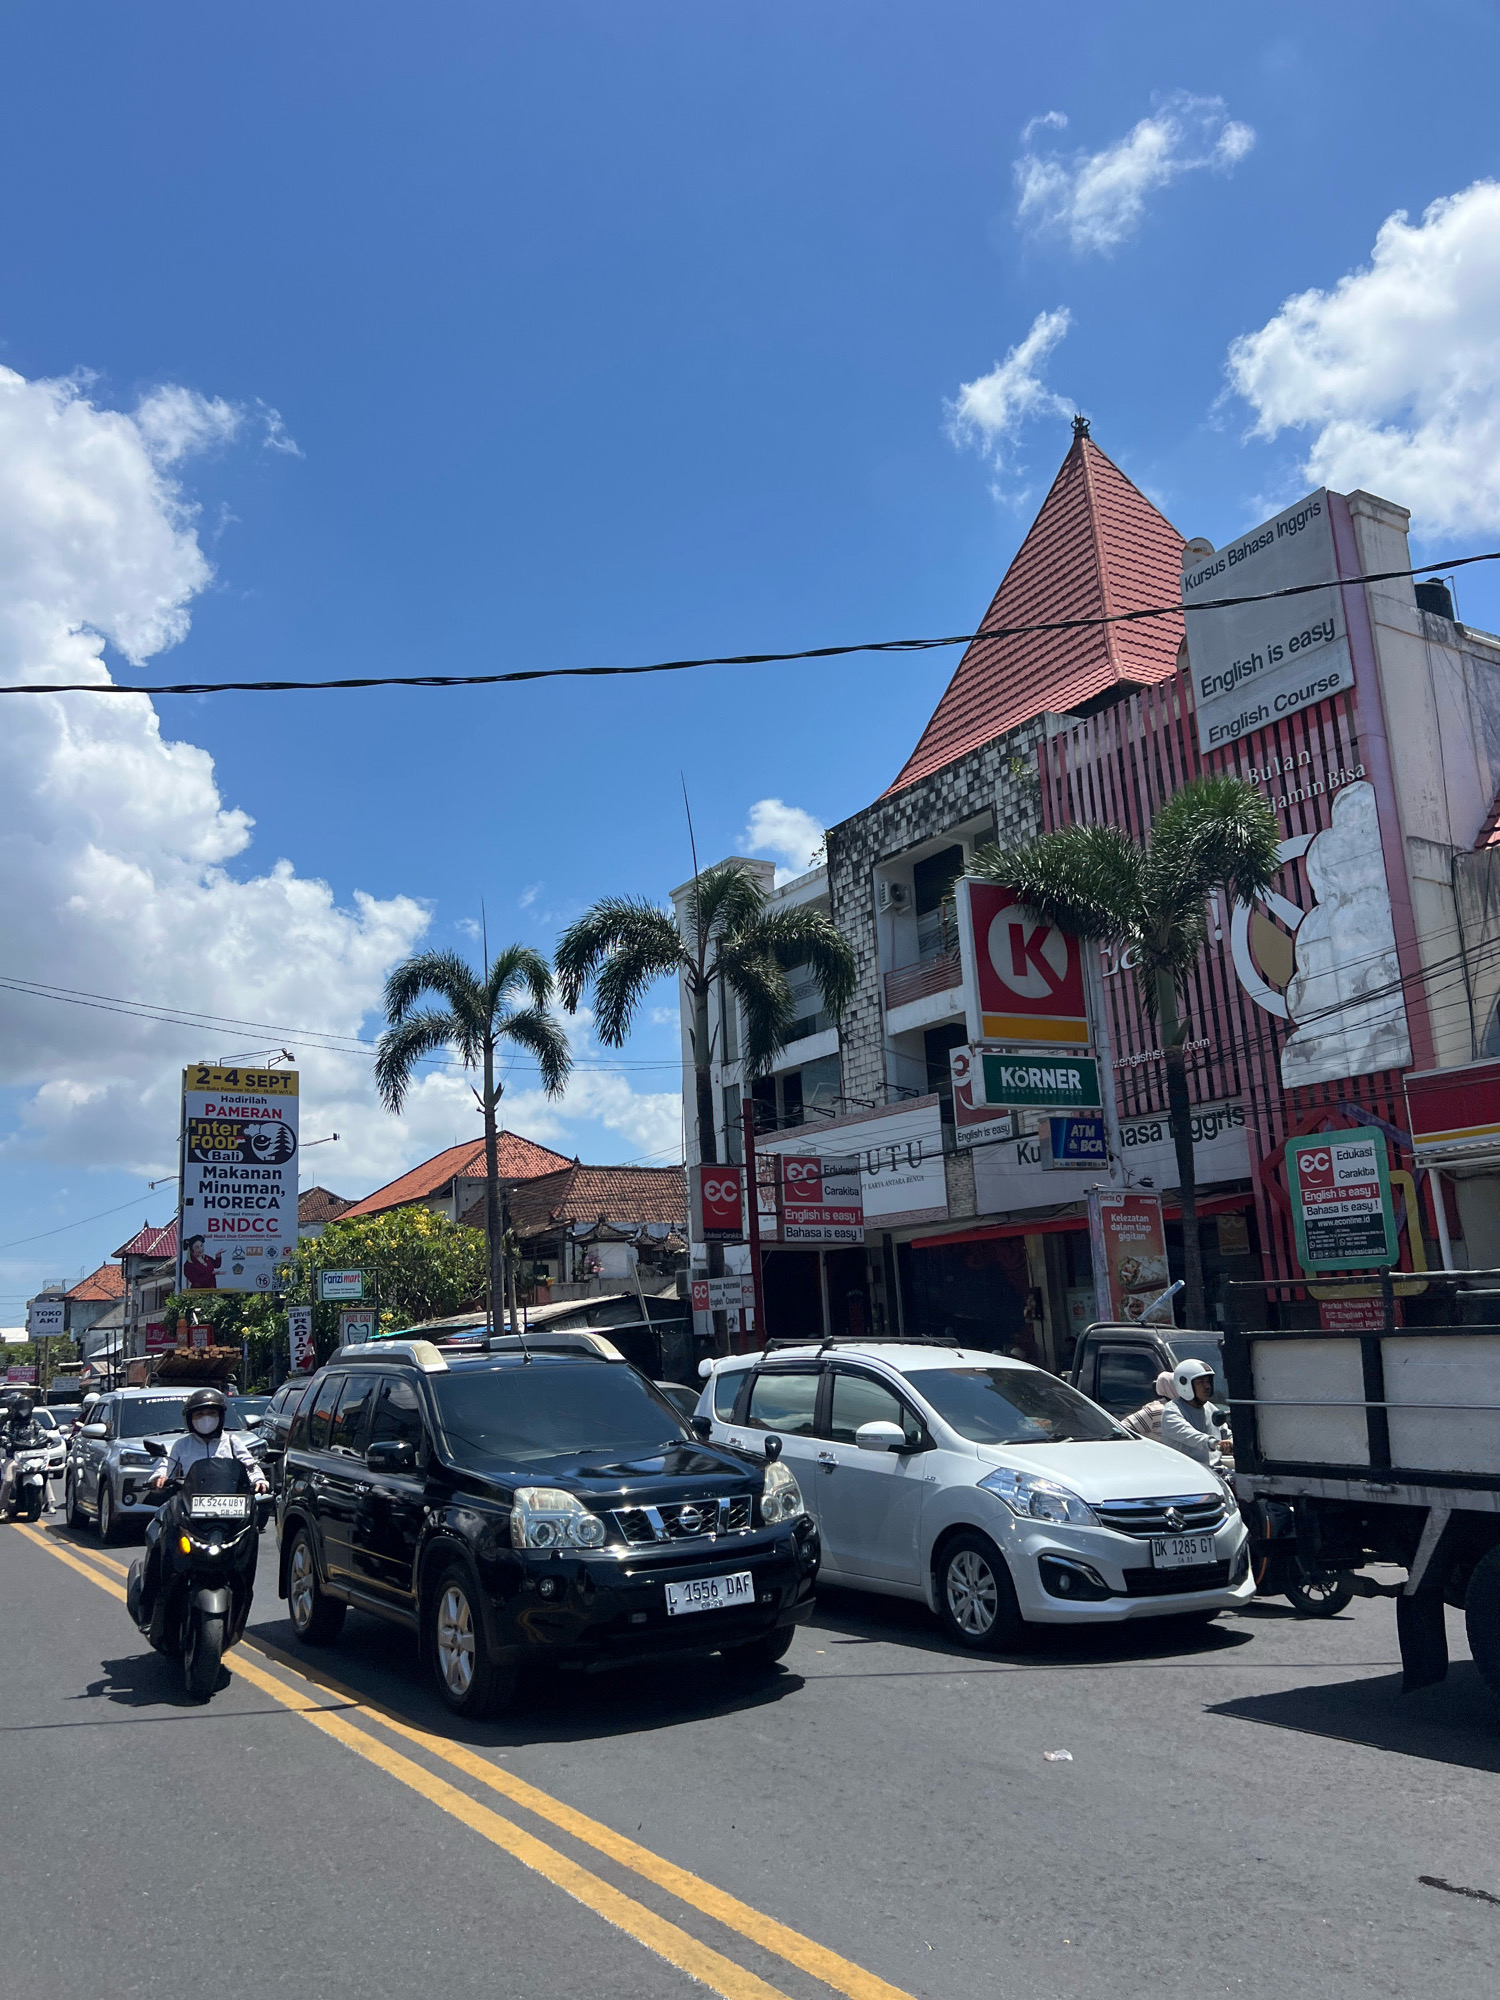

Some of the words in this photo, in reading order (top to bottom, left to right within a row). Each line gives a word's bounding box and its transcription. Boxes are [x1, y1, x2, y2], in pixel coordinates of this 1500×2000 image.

[1185, 559, 1225, 592] Kursus
[1228, 531, 1274, 568] Bahasa
[1276, 502, 1322, 538] Inggris
[1201, 653, 1263, 698] English
[1267, 645, 1283, 664] is
[1289, 618, 1335, 652] easy
[1209, 705, 1270, 744] English
[1273, 673, 1340, 712] Course
[1247, 750, 1312, 786] Bulan
[1327, 763, 1366, 790] Bisa
[1008, 923, 1064, 994] K
[245, 1074, 291, 1089] SEPT
[1000, 1066, 1083, 1089] KÖRNER
[221, 1095, 267, 1104] Hadirilah
[205, 1103, 282, 1119] PAMERAN
[957, 1128, 983, 1143] English
[984, 1126, 990, 1136] is
[992, 1125, 1010, 1137] easy
[1070, 1125, 1095, 1137] ATM
[190, 1135, 239, 1149] FOOD
[1080, 1140, 1103, 1152] BCA
[212, 1151, 239, 1161] Bali
[866, 1140, 923, 1176] UTU
[1017, 1142, 1041, 1166] Ku
[1336, 1147, 1373, 1160] Edukasi
[203, 1166, 282, 1180] Makanan
[1338, 1167, 1376, 1179] Carakita
[199, 1181, 285, 1197] Minuman,
[885, 1178, 906, 1187] ANTARA
[1304, 1189, 1337, 1202] English
[1338, 1188, 1347, 1198] is
[1348, 1187, 1371, 1198] easy
[204, 1196, 280, 1209] HORECA
[1306, 1204, 1339, 1216] Bahasa
[1341, 1203, 1349, 1213] is
[1351, 1202, 1373, 1214] easy
[785, 1208, 820, 1222] English
[822, 1209, 831, 1221] is
[832, 1210, 856, 1224] easy
[1111, 1214, 1149, 1223] Kelezatan
[208, 1218, 279, 1233] BNDCC
[1111, 1223, 1135, 1231] dalam
[1136, 1223, 1152, 1233] tiap
[786, 1228, 822, 1239] Bahasa
[824, 1227, 832, 1238] is
[834, 1229, 857, 1241] easy
[1118, 1232, 1146, 1241] gigitan
[343, 1273, 361, 1284] mart
[1344, 1301, 1371, 1309] Khusus
[1338, 1311, 1364, 1320] English
[194, 1498, 206, 1507] DK
[207, 1498, 227, 1507] 5244
[229, 1498, 244, 1507] UBY
[1154, 1540, 1167, 1556] DK
[1172, 1539, 1197, 1555] 1285
[1200, 1538, 1212, 1553] GT
[668, 1587, 677, 1604] L
[684, 1580, 718, 1602] 1556
[726, 1574, 750, 1595] DAF
